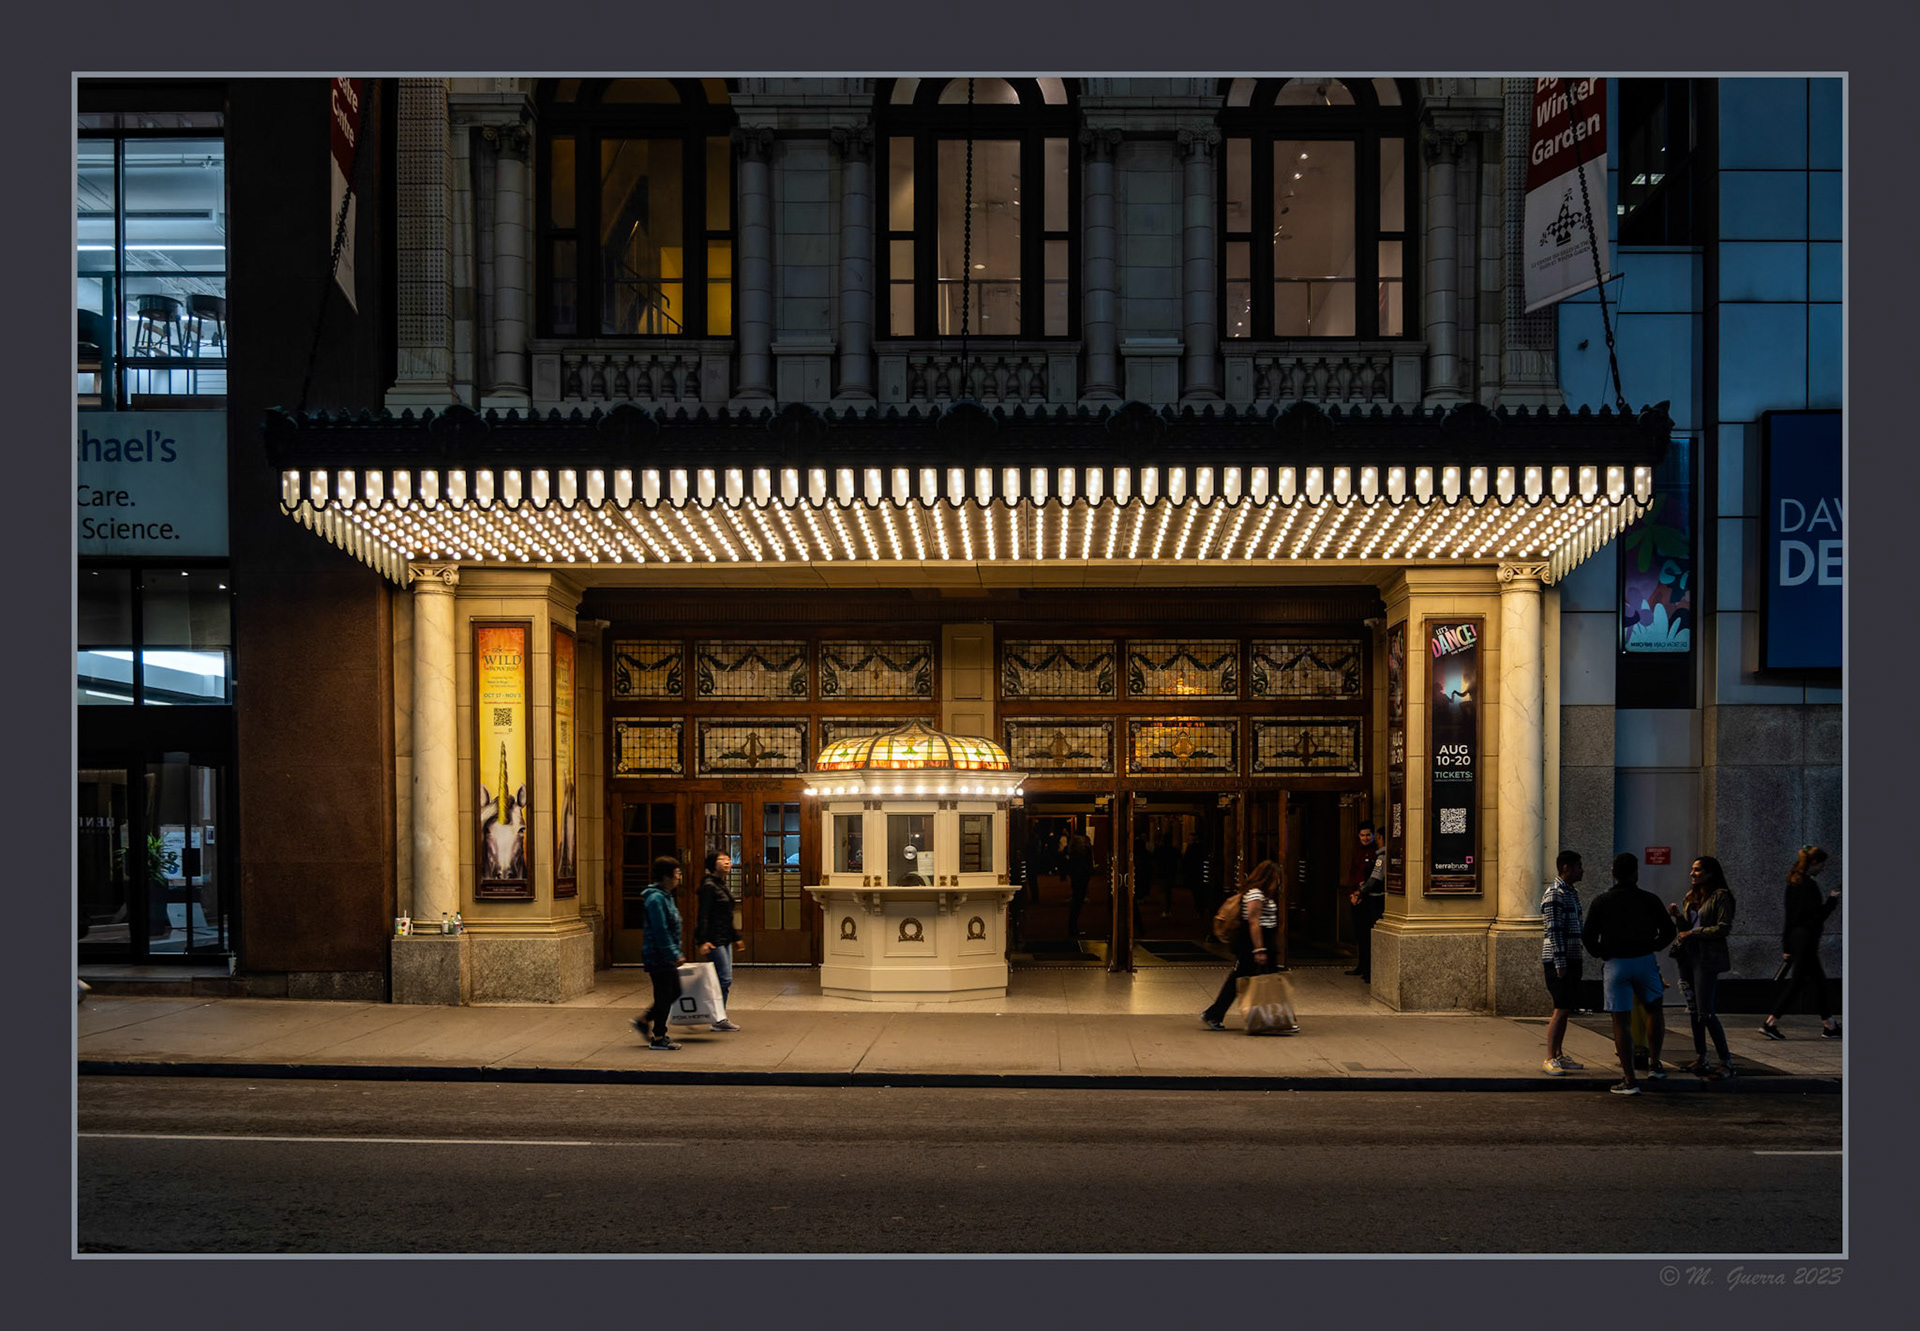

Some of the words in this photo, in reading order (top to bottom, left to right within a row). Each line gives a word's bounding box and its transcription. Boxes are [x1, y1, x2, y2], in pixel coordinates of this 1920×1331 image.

[1537, 78, 1598, 128] Winter
[1532, 113, 1600, 166] Garden
[78, 429, 177, 463] hael's
[78, 485, 135, 506] Care.
[83, 518, 179, 540] Science.
[1432, 624, 1477, 658] DANCE!
[484, 655, 522, 665] WILD
[1439, 744, 1469, 755] AUG
[1436, 755, 1471, 766] 10-20
[1434, 771, 1473, 779] TICKETS:
[1435, 862, 1469, 870] terrabruce
